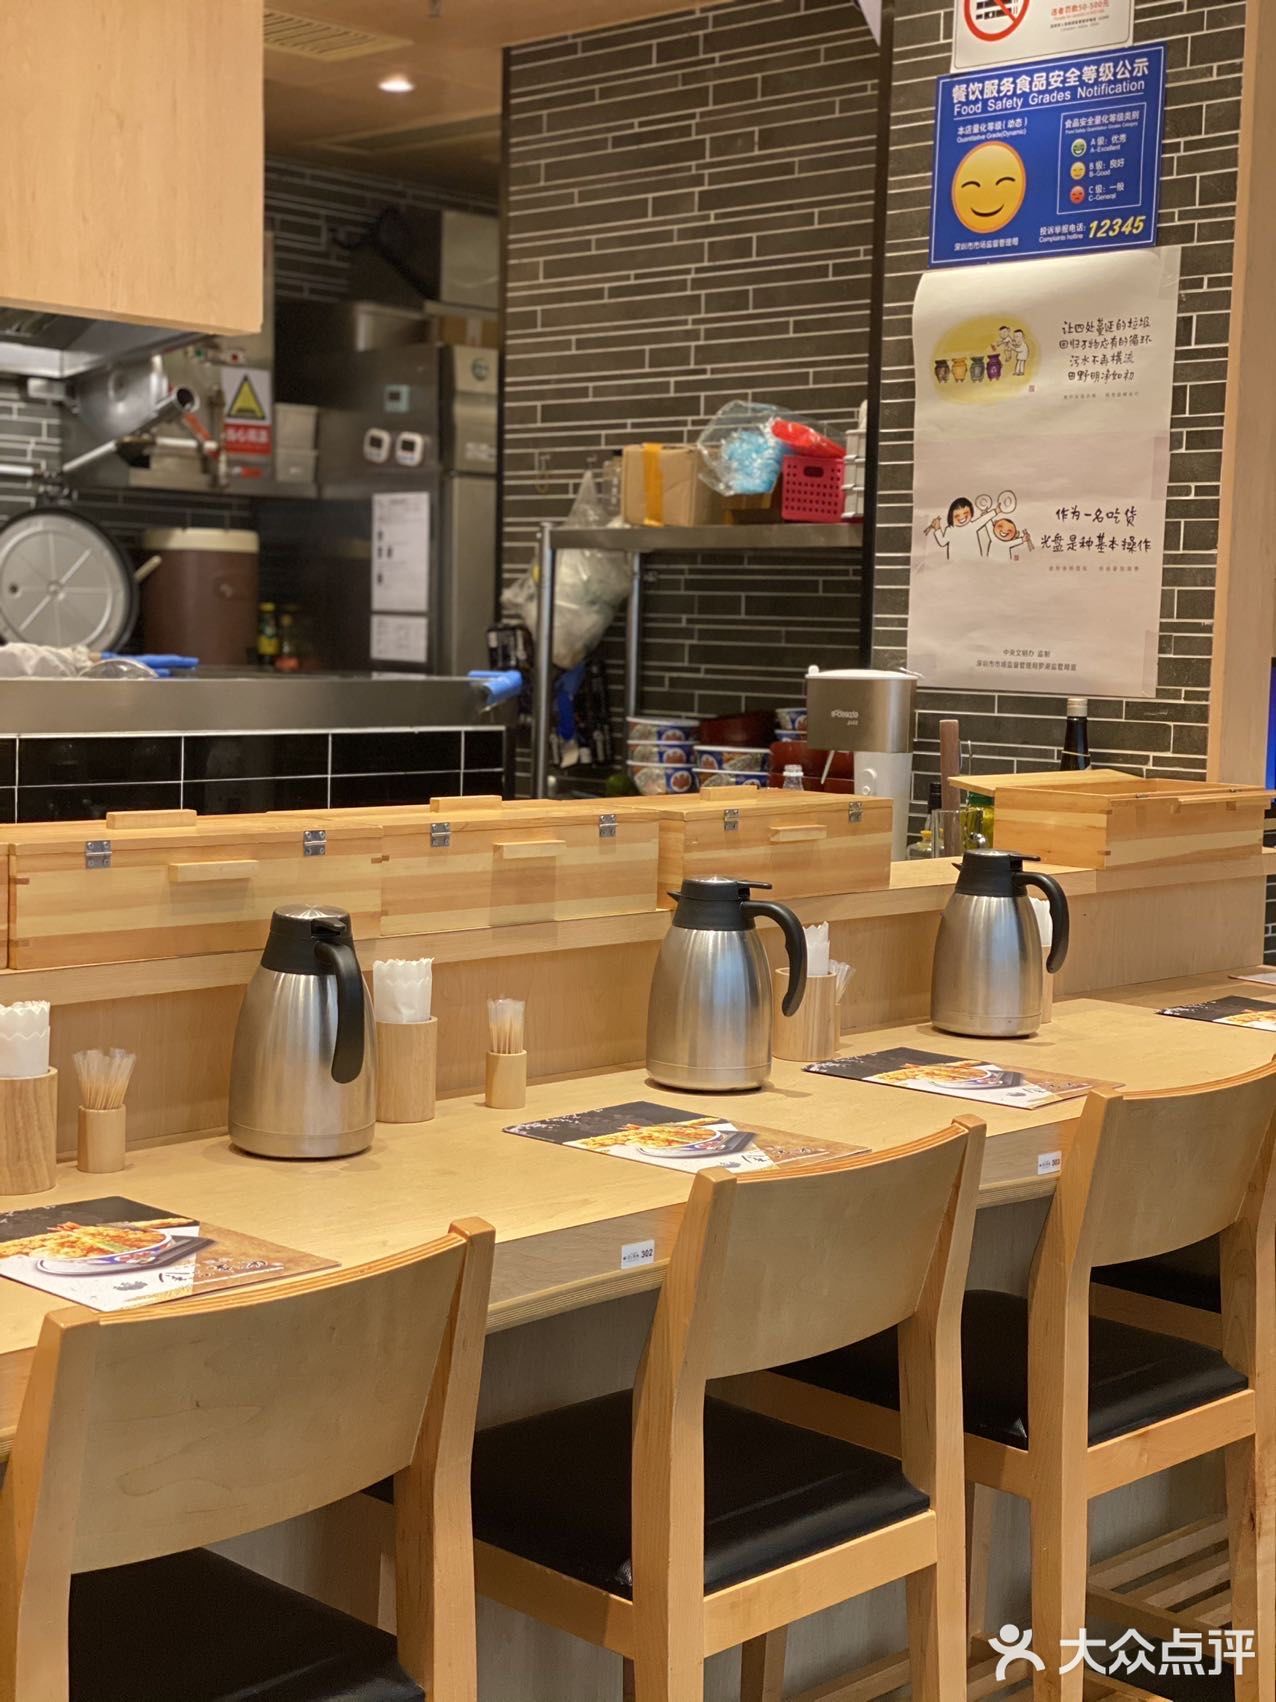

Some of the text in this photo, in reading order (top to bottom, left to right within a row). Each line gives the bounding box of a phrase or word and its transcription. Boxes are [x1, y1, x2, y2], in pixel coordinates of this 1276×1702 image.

[952, 57, 1149, 103] 餐饮服务食品安全等级公示
[953, 79, 1145, 116] Food Safety Grades Notification
[1088, 215, 1147, 239] 12345
[1061, 315, 1151, 336] 让四处蔓延的垃圾
[1058, 334, 1152, 350] 回归万物应有的循环
[1069, 350, 1135, 367] 污水不再横流
[1067, 368, 1135, 384] 田野明净如初
[1055, 505, 1137, 527] 作为一名吃货
[1040, 532, 1152, 554] 光盘是种基本操作
[641, 1248, 653, 1259] 302
